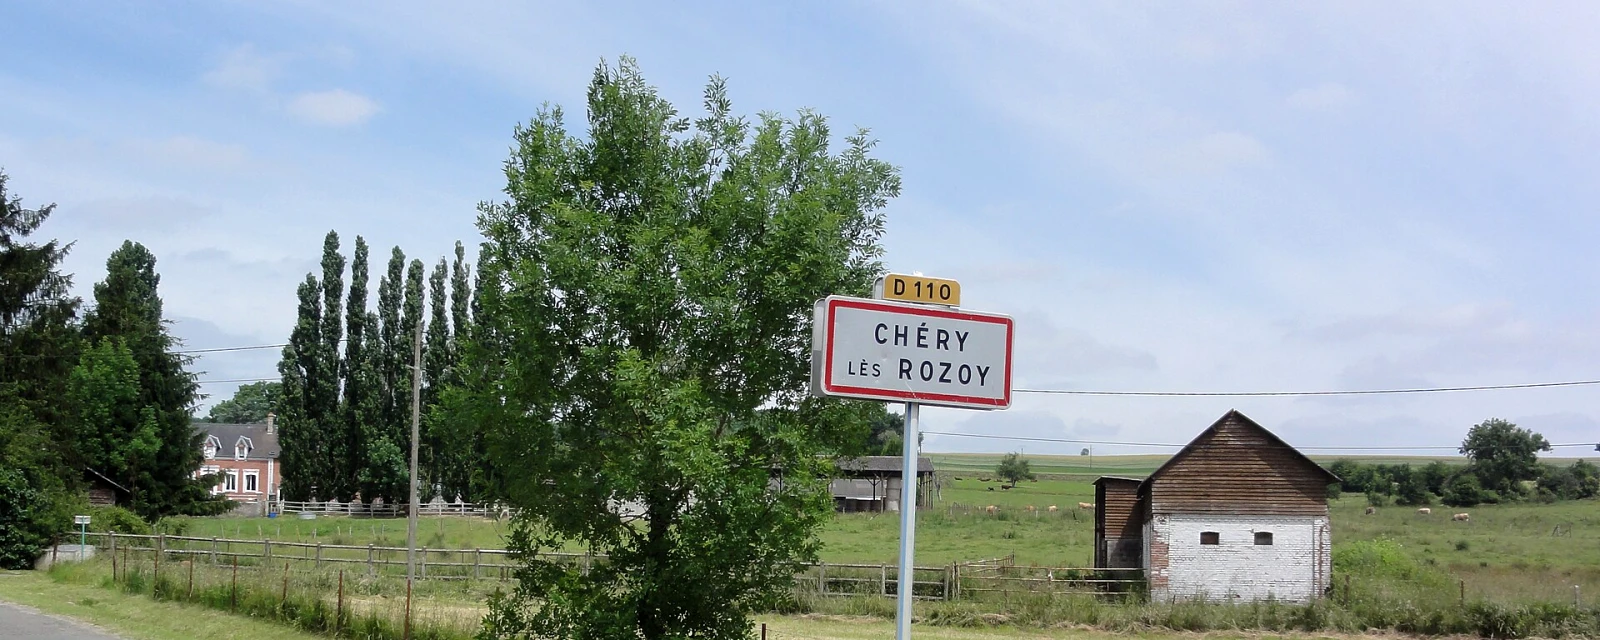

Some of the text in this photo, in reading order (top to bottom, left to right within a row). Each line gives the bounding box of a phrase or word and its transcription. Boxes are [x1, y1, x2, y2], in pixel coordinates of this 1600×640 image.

[894, 278, 951, 300] D 110
[874, 322, 969, 352] CHÉRY
[848, 358, 990, 386] LÈS ROZOY
